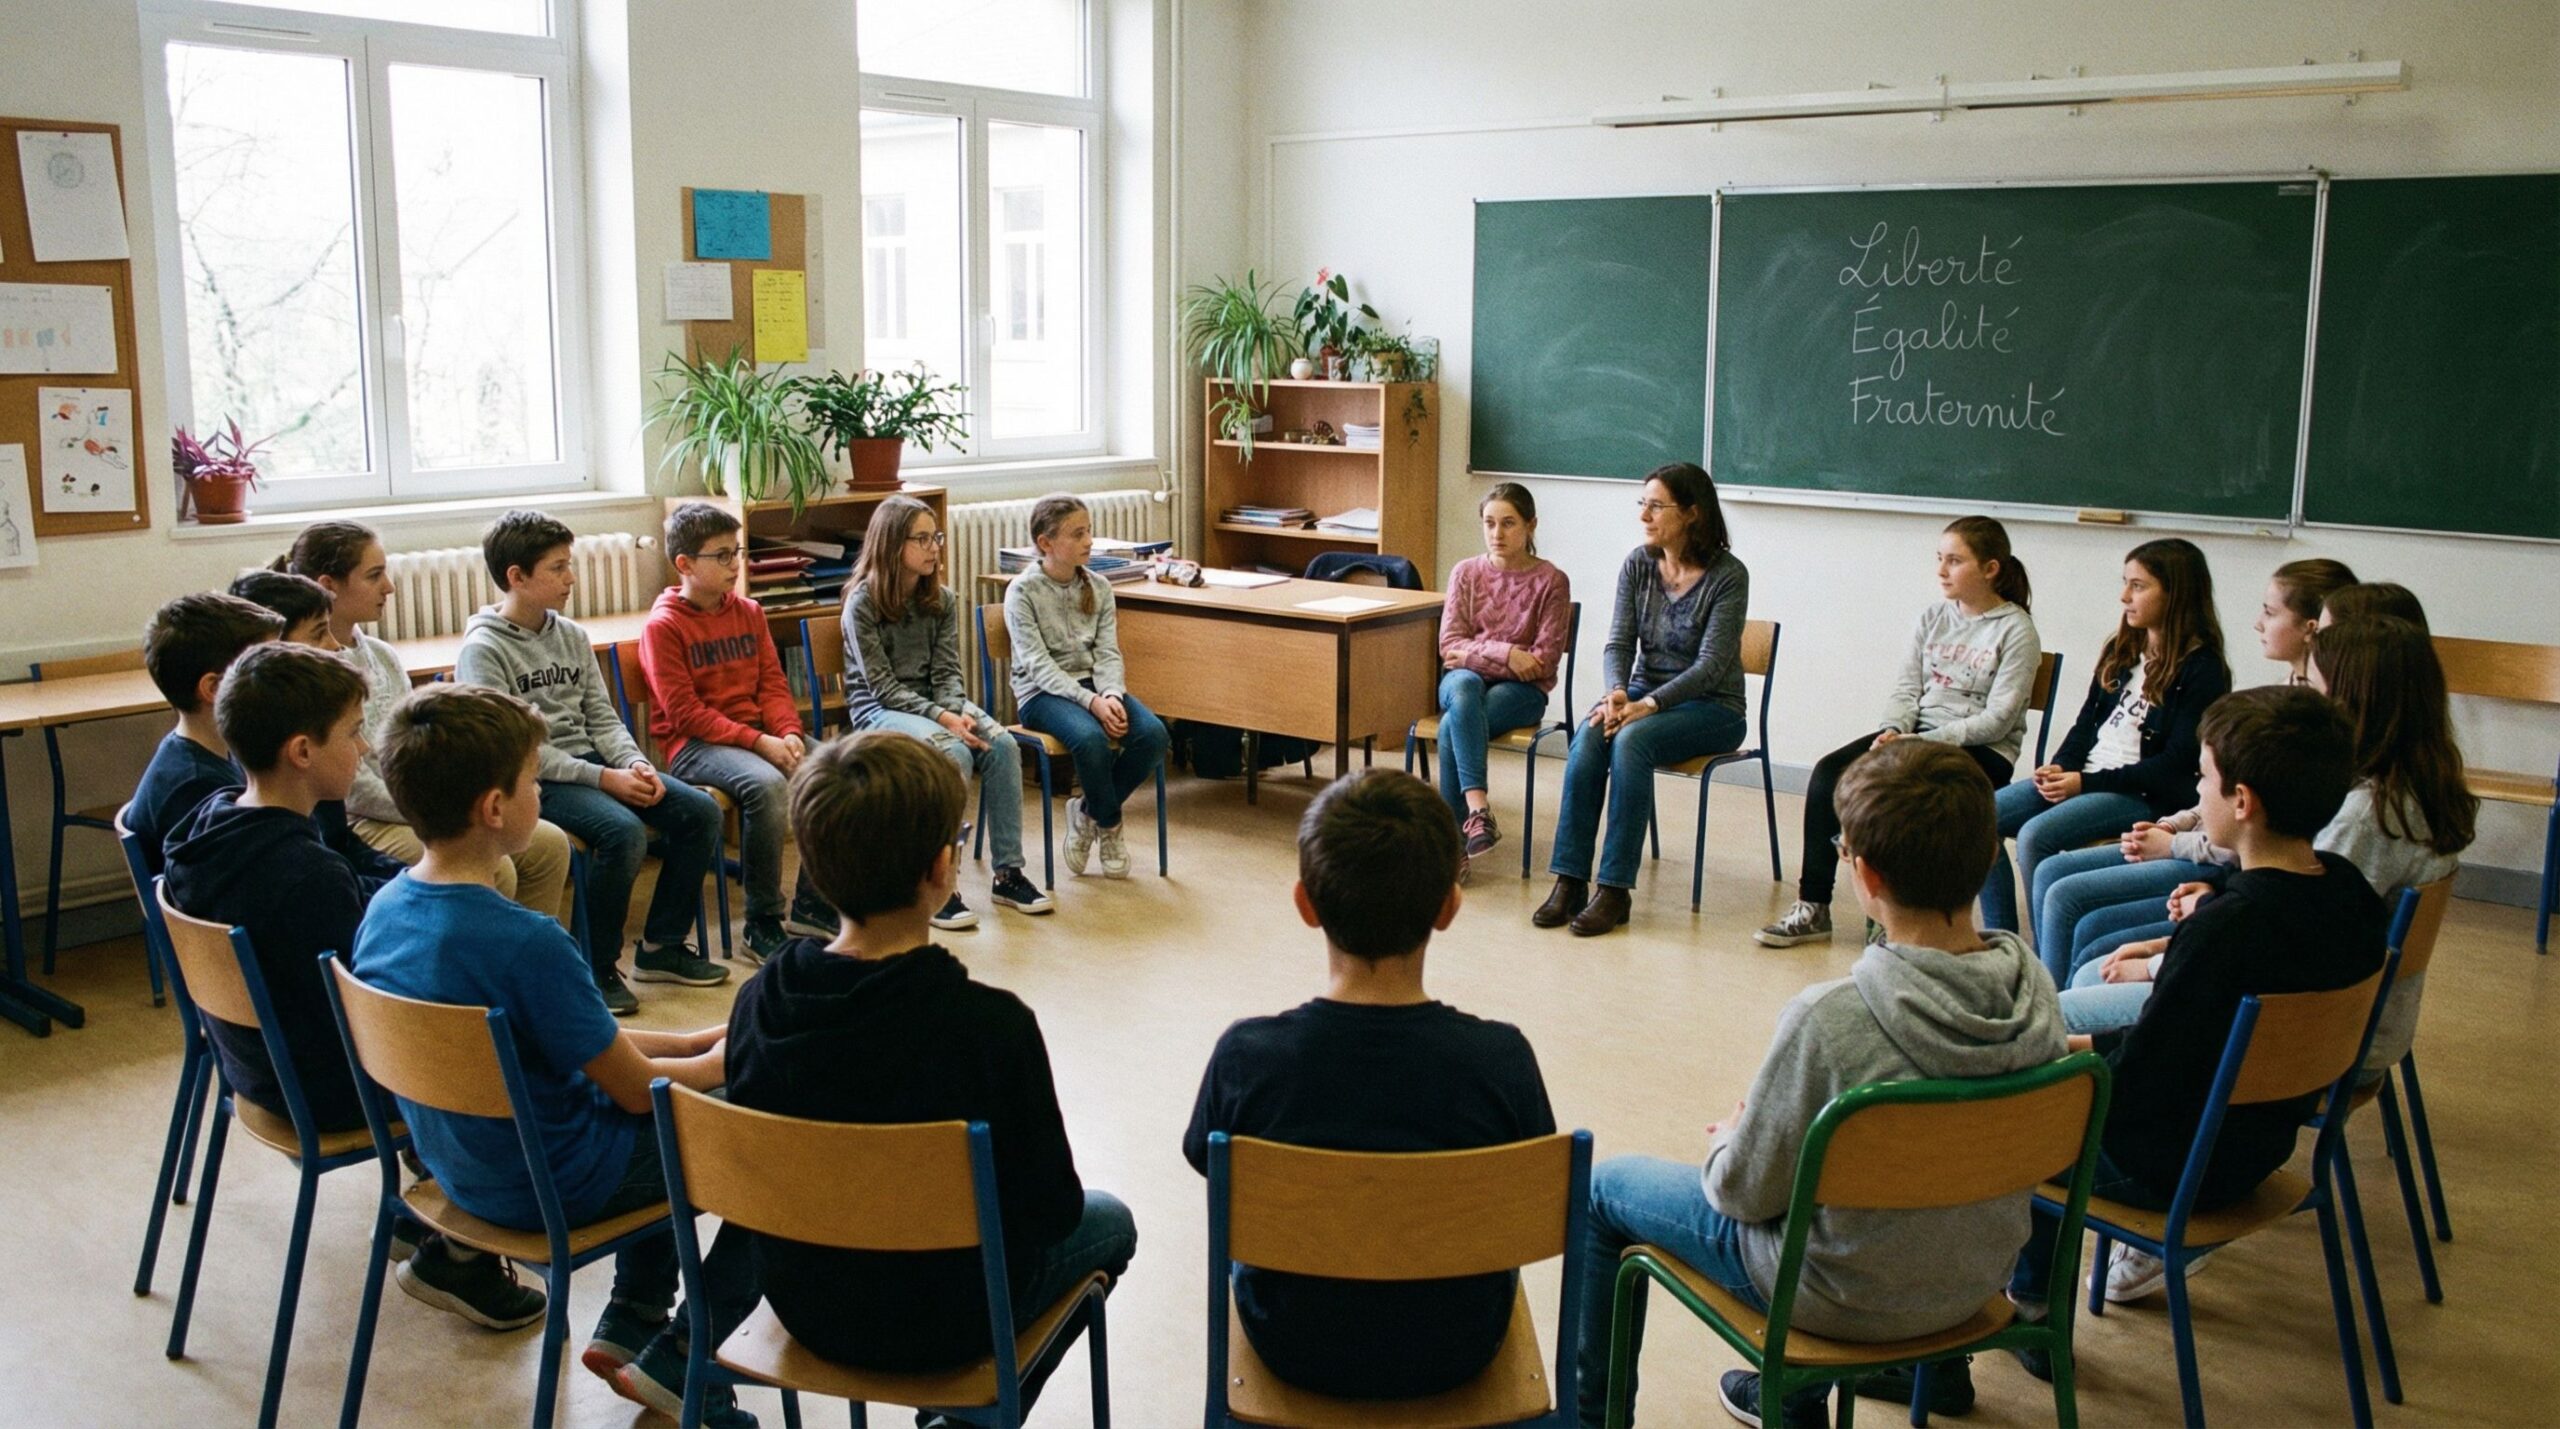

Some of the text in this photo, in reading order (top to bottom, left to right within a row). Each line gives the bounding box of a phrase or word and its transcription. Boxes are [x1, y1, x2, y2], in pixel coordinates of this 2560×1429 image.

[1839, 221, 2023, 288] Liberté
[1853, 293, 2020, 381] Égalité
[1849, 375, 2067, 436] Fraternité
